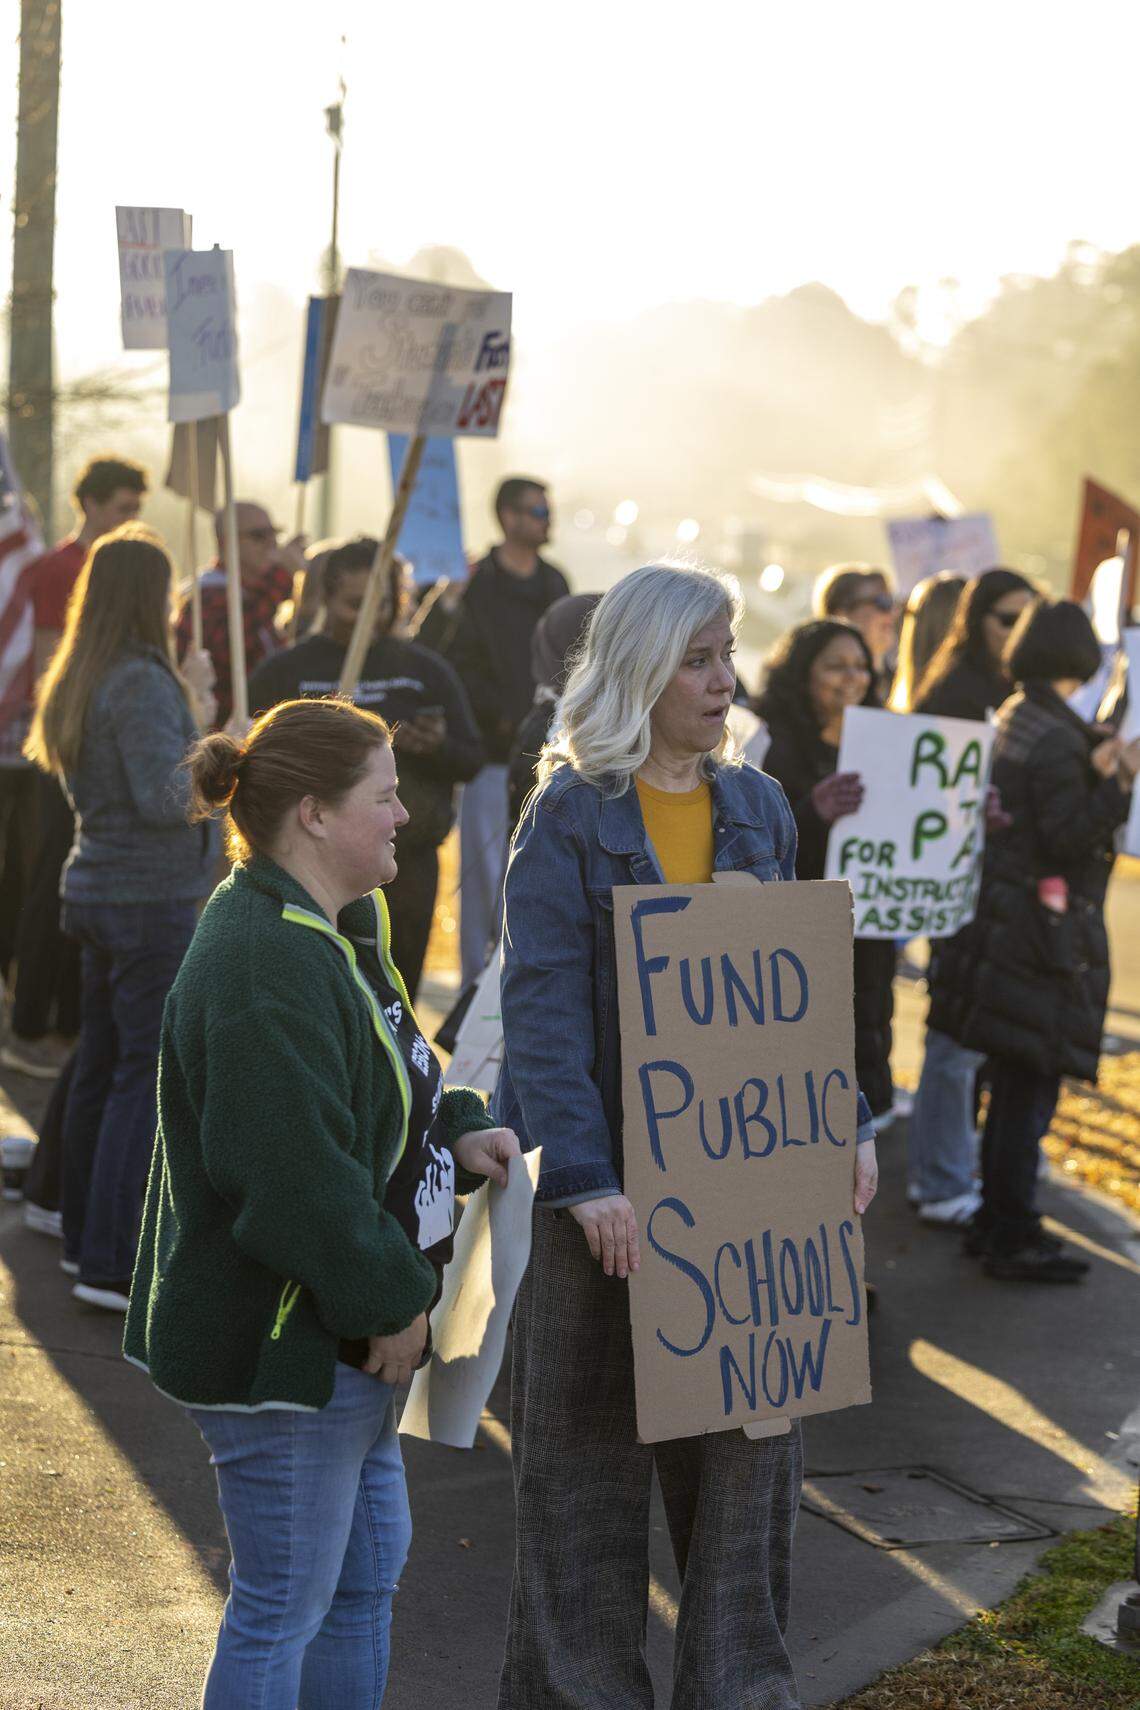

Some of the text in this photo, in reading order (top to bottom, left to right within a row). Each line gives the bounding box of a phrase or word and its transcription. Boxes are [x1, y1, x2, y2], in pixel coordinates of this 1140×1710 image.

[840, 835, 897, 875] FOR
[630, 895, 809, 1036] FUND
[638, 1060, 849, 1173] PUBLIC
[646, 1196, 861, 1358] SCHOOLS
[719, 1318, 833, 1416] NOW
